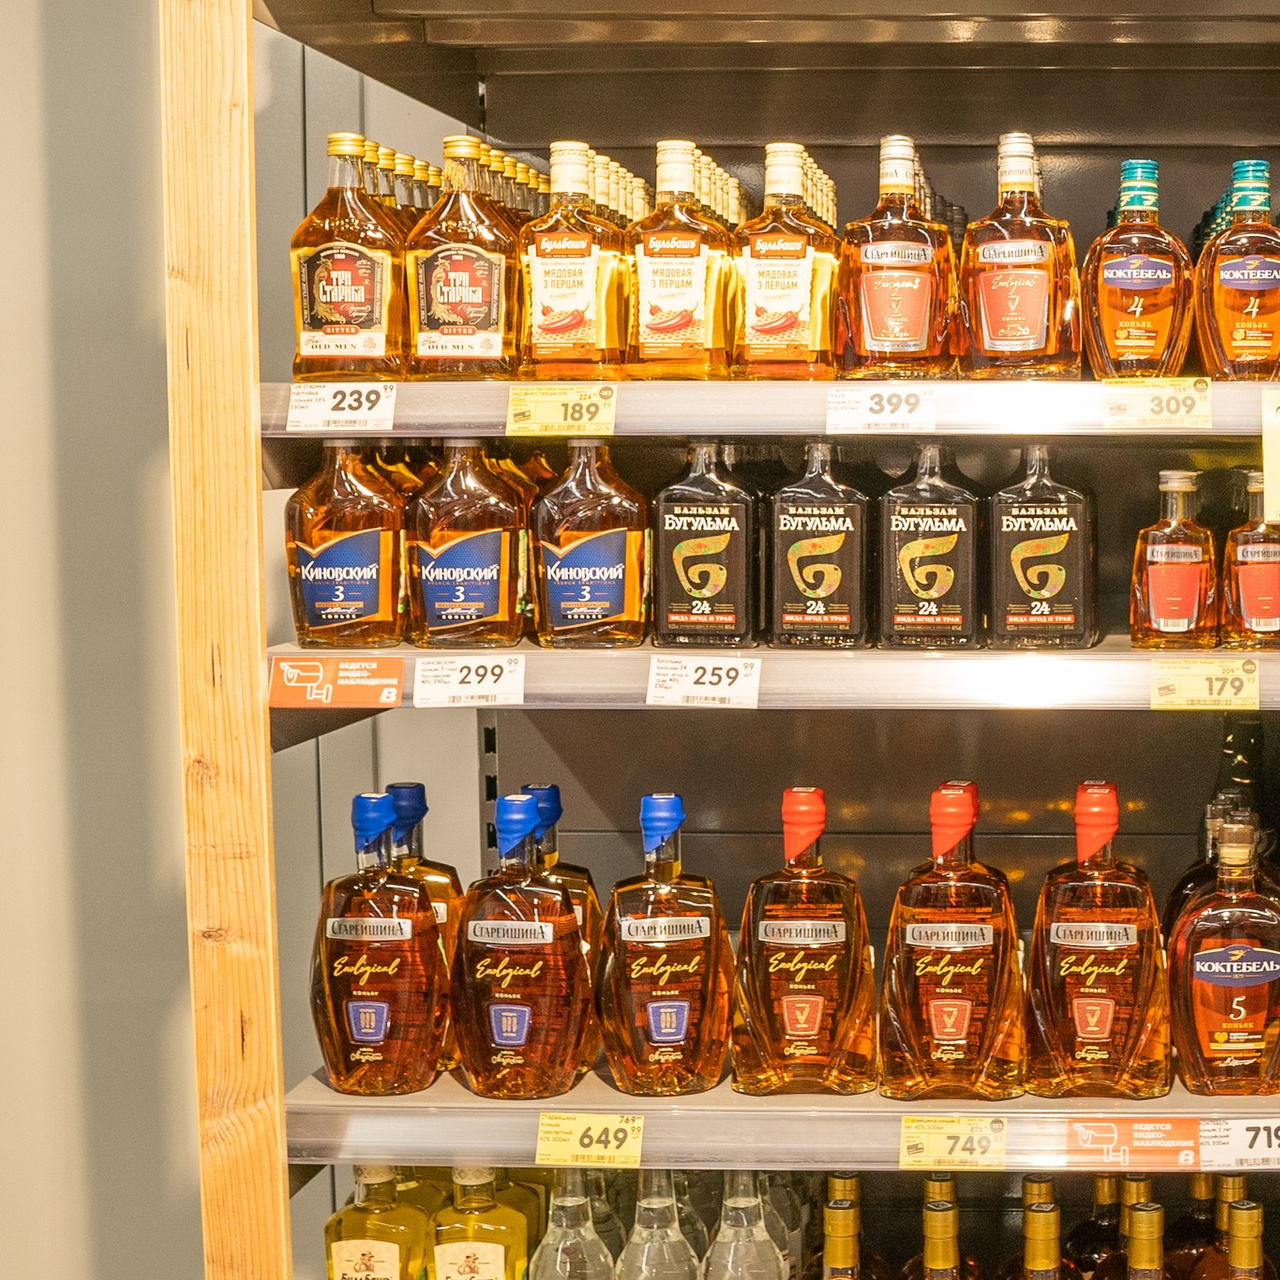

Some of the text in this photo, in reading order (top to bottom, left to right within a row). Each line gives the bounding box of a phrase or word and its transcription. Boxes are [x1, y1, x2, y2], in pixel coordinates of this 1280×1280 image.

[543, 269, 583, 278] МЯДОВАЯ
[1104, 267, 1171, 281] КОКТЕБЕЛЬ
[552, 280, 584, 289] ПЕРЦАМ
[1127, 295, 1143, 315] 4
[1243, 296, 1259, 316] 4
[331, 389, 381, 412] 239
[869, 393, 921, 415] 399
[1150, 396, 1196, 414] 309
[561, 403, 599, 422] 189
[665, 515, 739, 532] БУГУЛЬМА
[779, 515, 854, 532] БУГУЛЬМА
[891, 515, 966, 532] БУГУЛЬМА
[1002, 515, 1077, 532] БУГУЛЬМА
[337, 678, 399, 686] НАБЛЮДЕНИЕ
[459, 666, 504, 685] 299
[692, 668, 739, 686] 259
[1205, 677, 1244, 696] 179
[332, 921, 404, 936] СТАРЕЙШИНА
[627, 918, 704, 935] СТАРЕЙШИНА
[1195, 961, 1280, 974] КОКТЕБЕЛЬ
[1230, 997, 1245, 1020] 5
[579, 1127, 629, 1149] 649
[947, 1135, 991, 1156] 749
